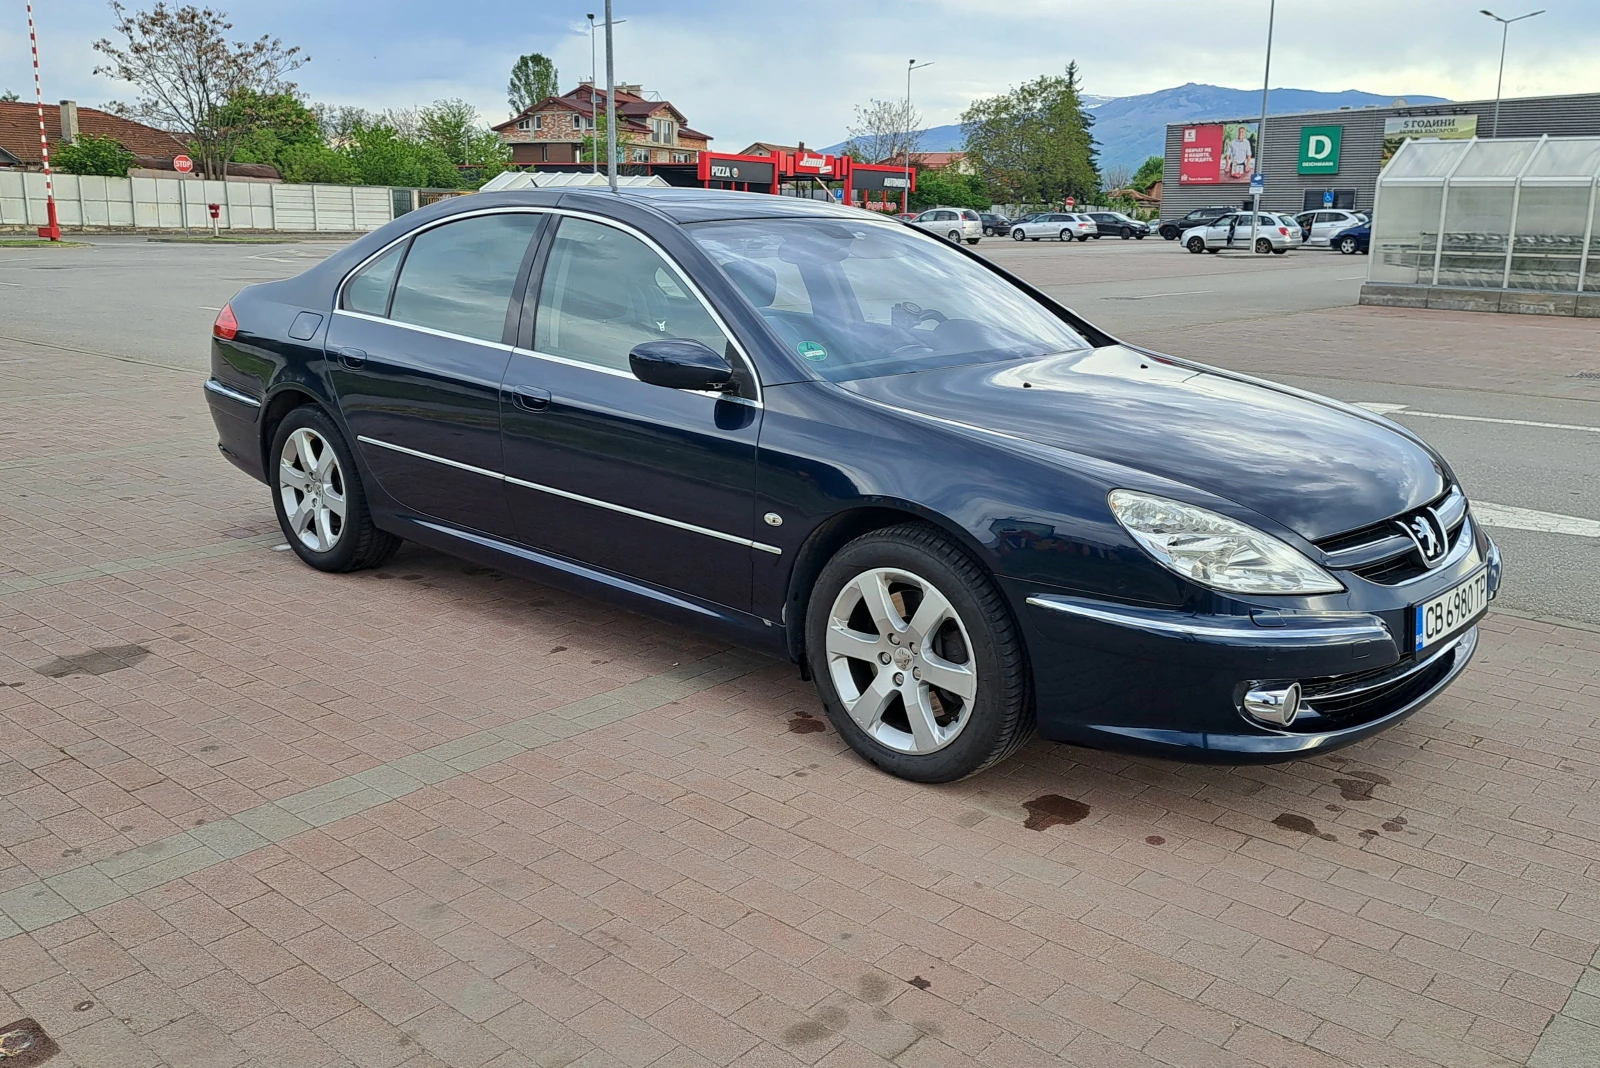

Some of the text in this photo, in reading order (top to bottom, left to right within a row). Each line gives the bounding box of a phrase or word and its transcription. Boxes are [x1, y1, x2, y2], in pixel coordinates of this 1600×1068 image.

[1403, 118, 1456, 128] 5 ГОДИНИ
[1308, 135, 1332, 159] D
[175, 160, 191, 168] STOP
[711, 165, 731, 177] PIZZA
[1426, 574, 1485, 639] CB 6980 TP
[1416, 634, 1422, 644] BG
